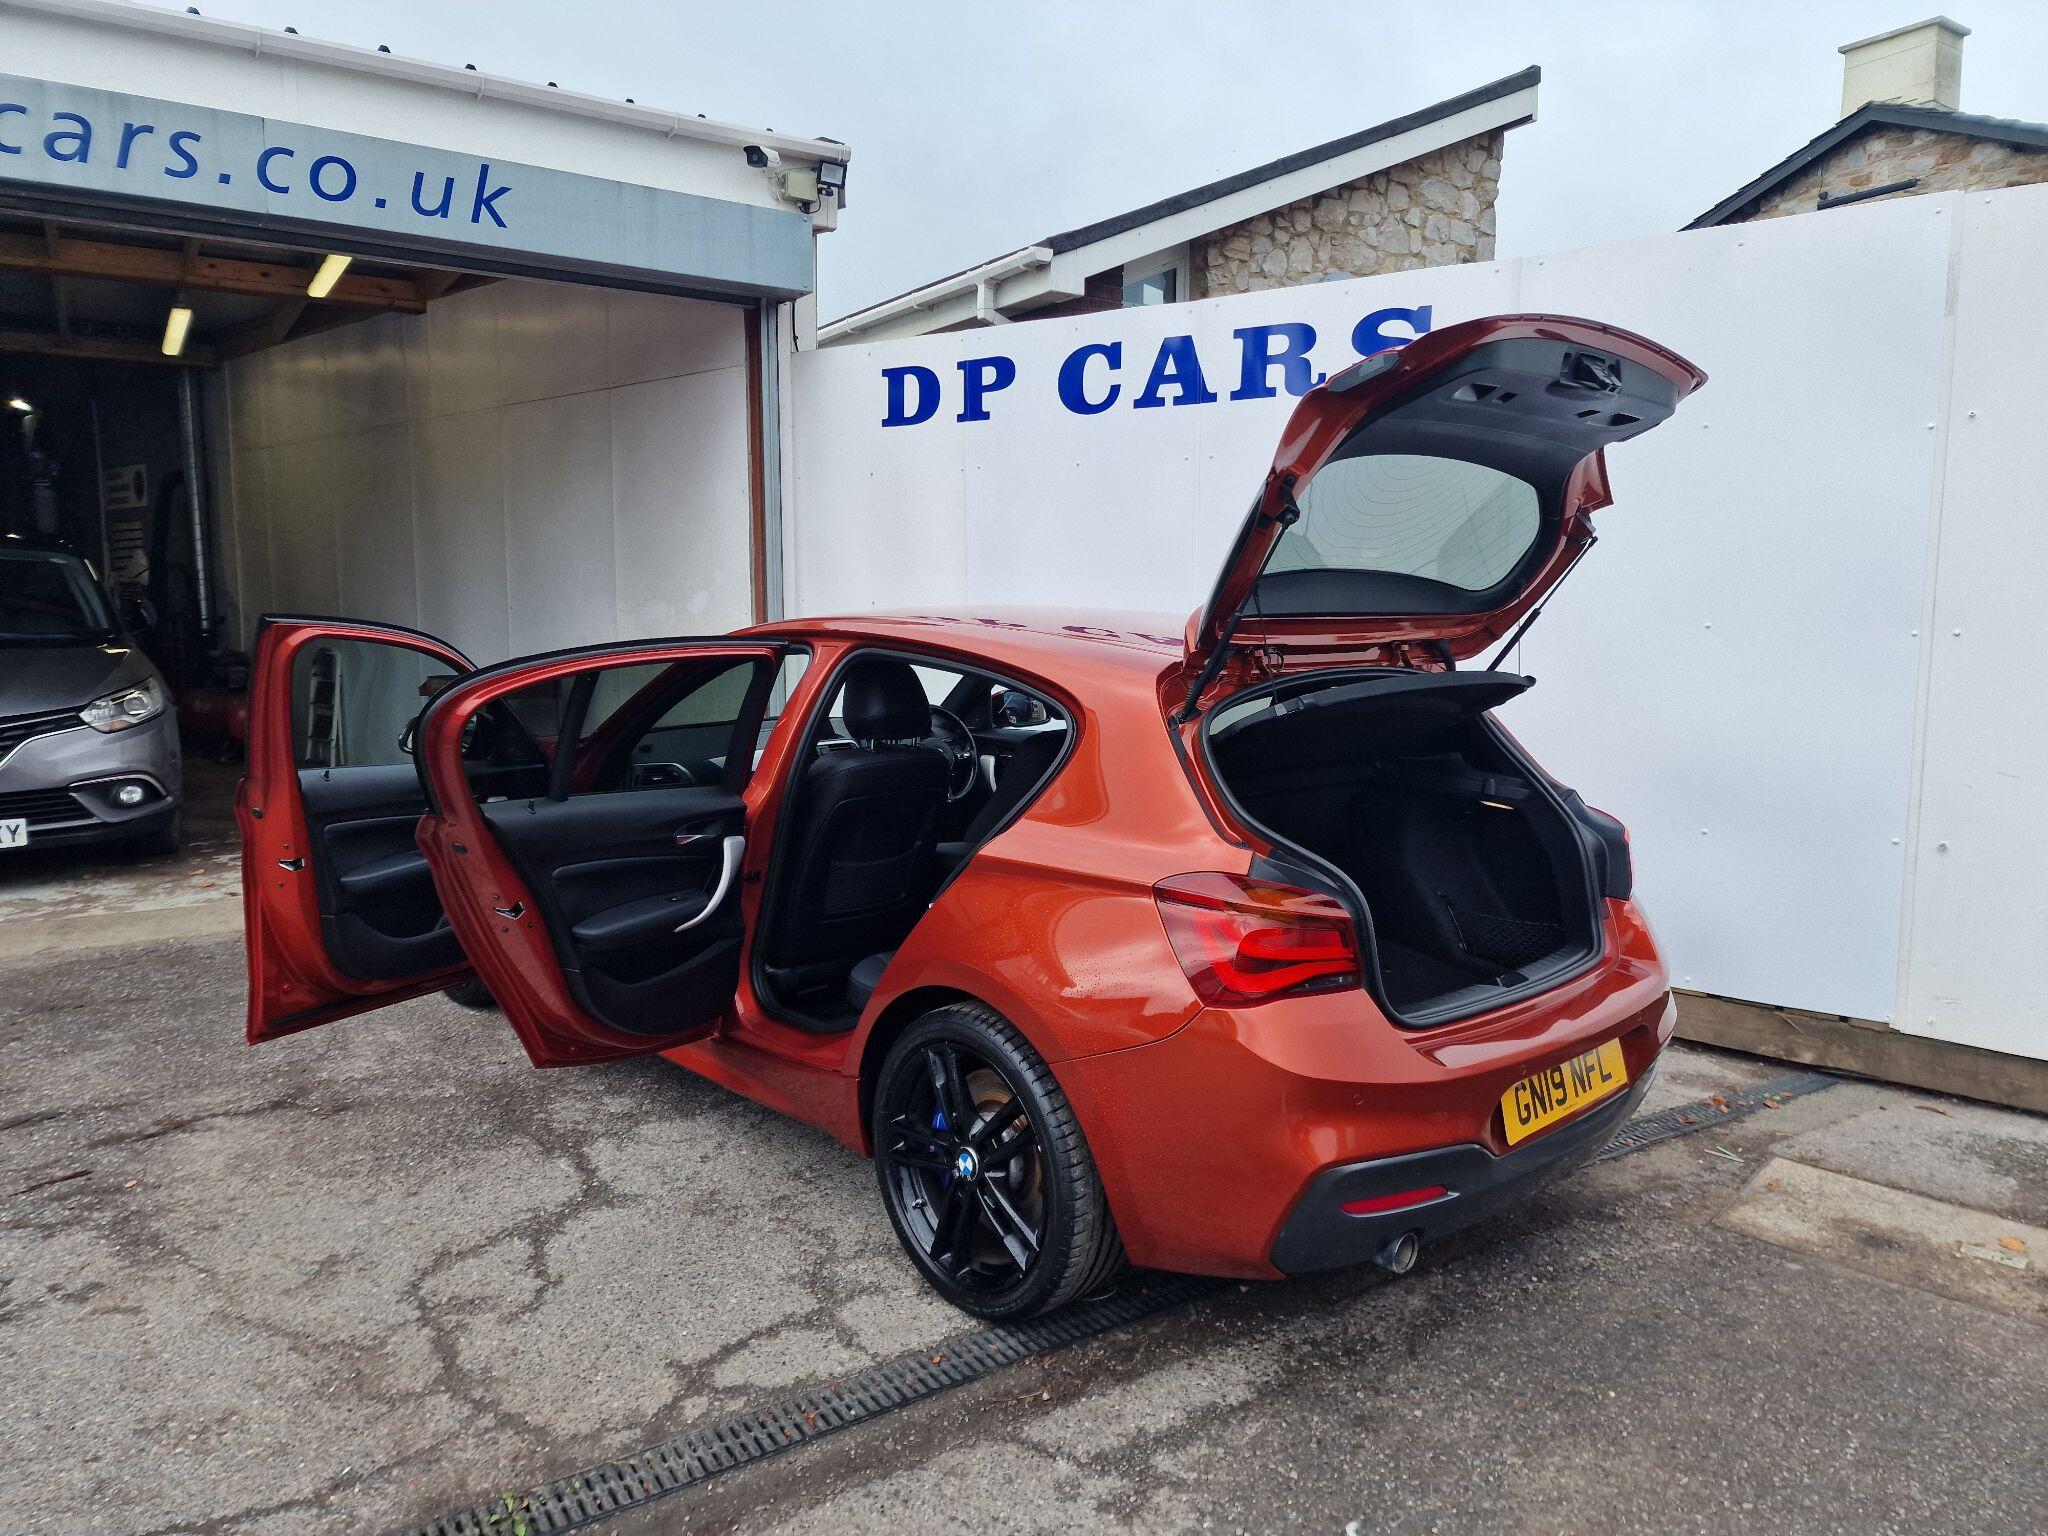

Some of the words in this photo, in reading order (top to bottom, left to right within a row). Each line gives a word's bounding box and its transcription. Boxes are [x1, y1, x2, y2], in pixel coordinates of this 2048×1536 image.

[881, 355, 1016, 427] DP
[1514, 1065, 1568, 1126] GN19
[1568, 1048, 1613, 1098] NFL
